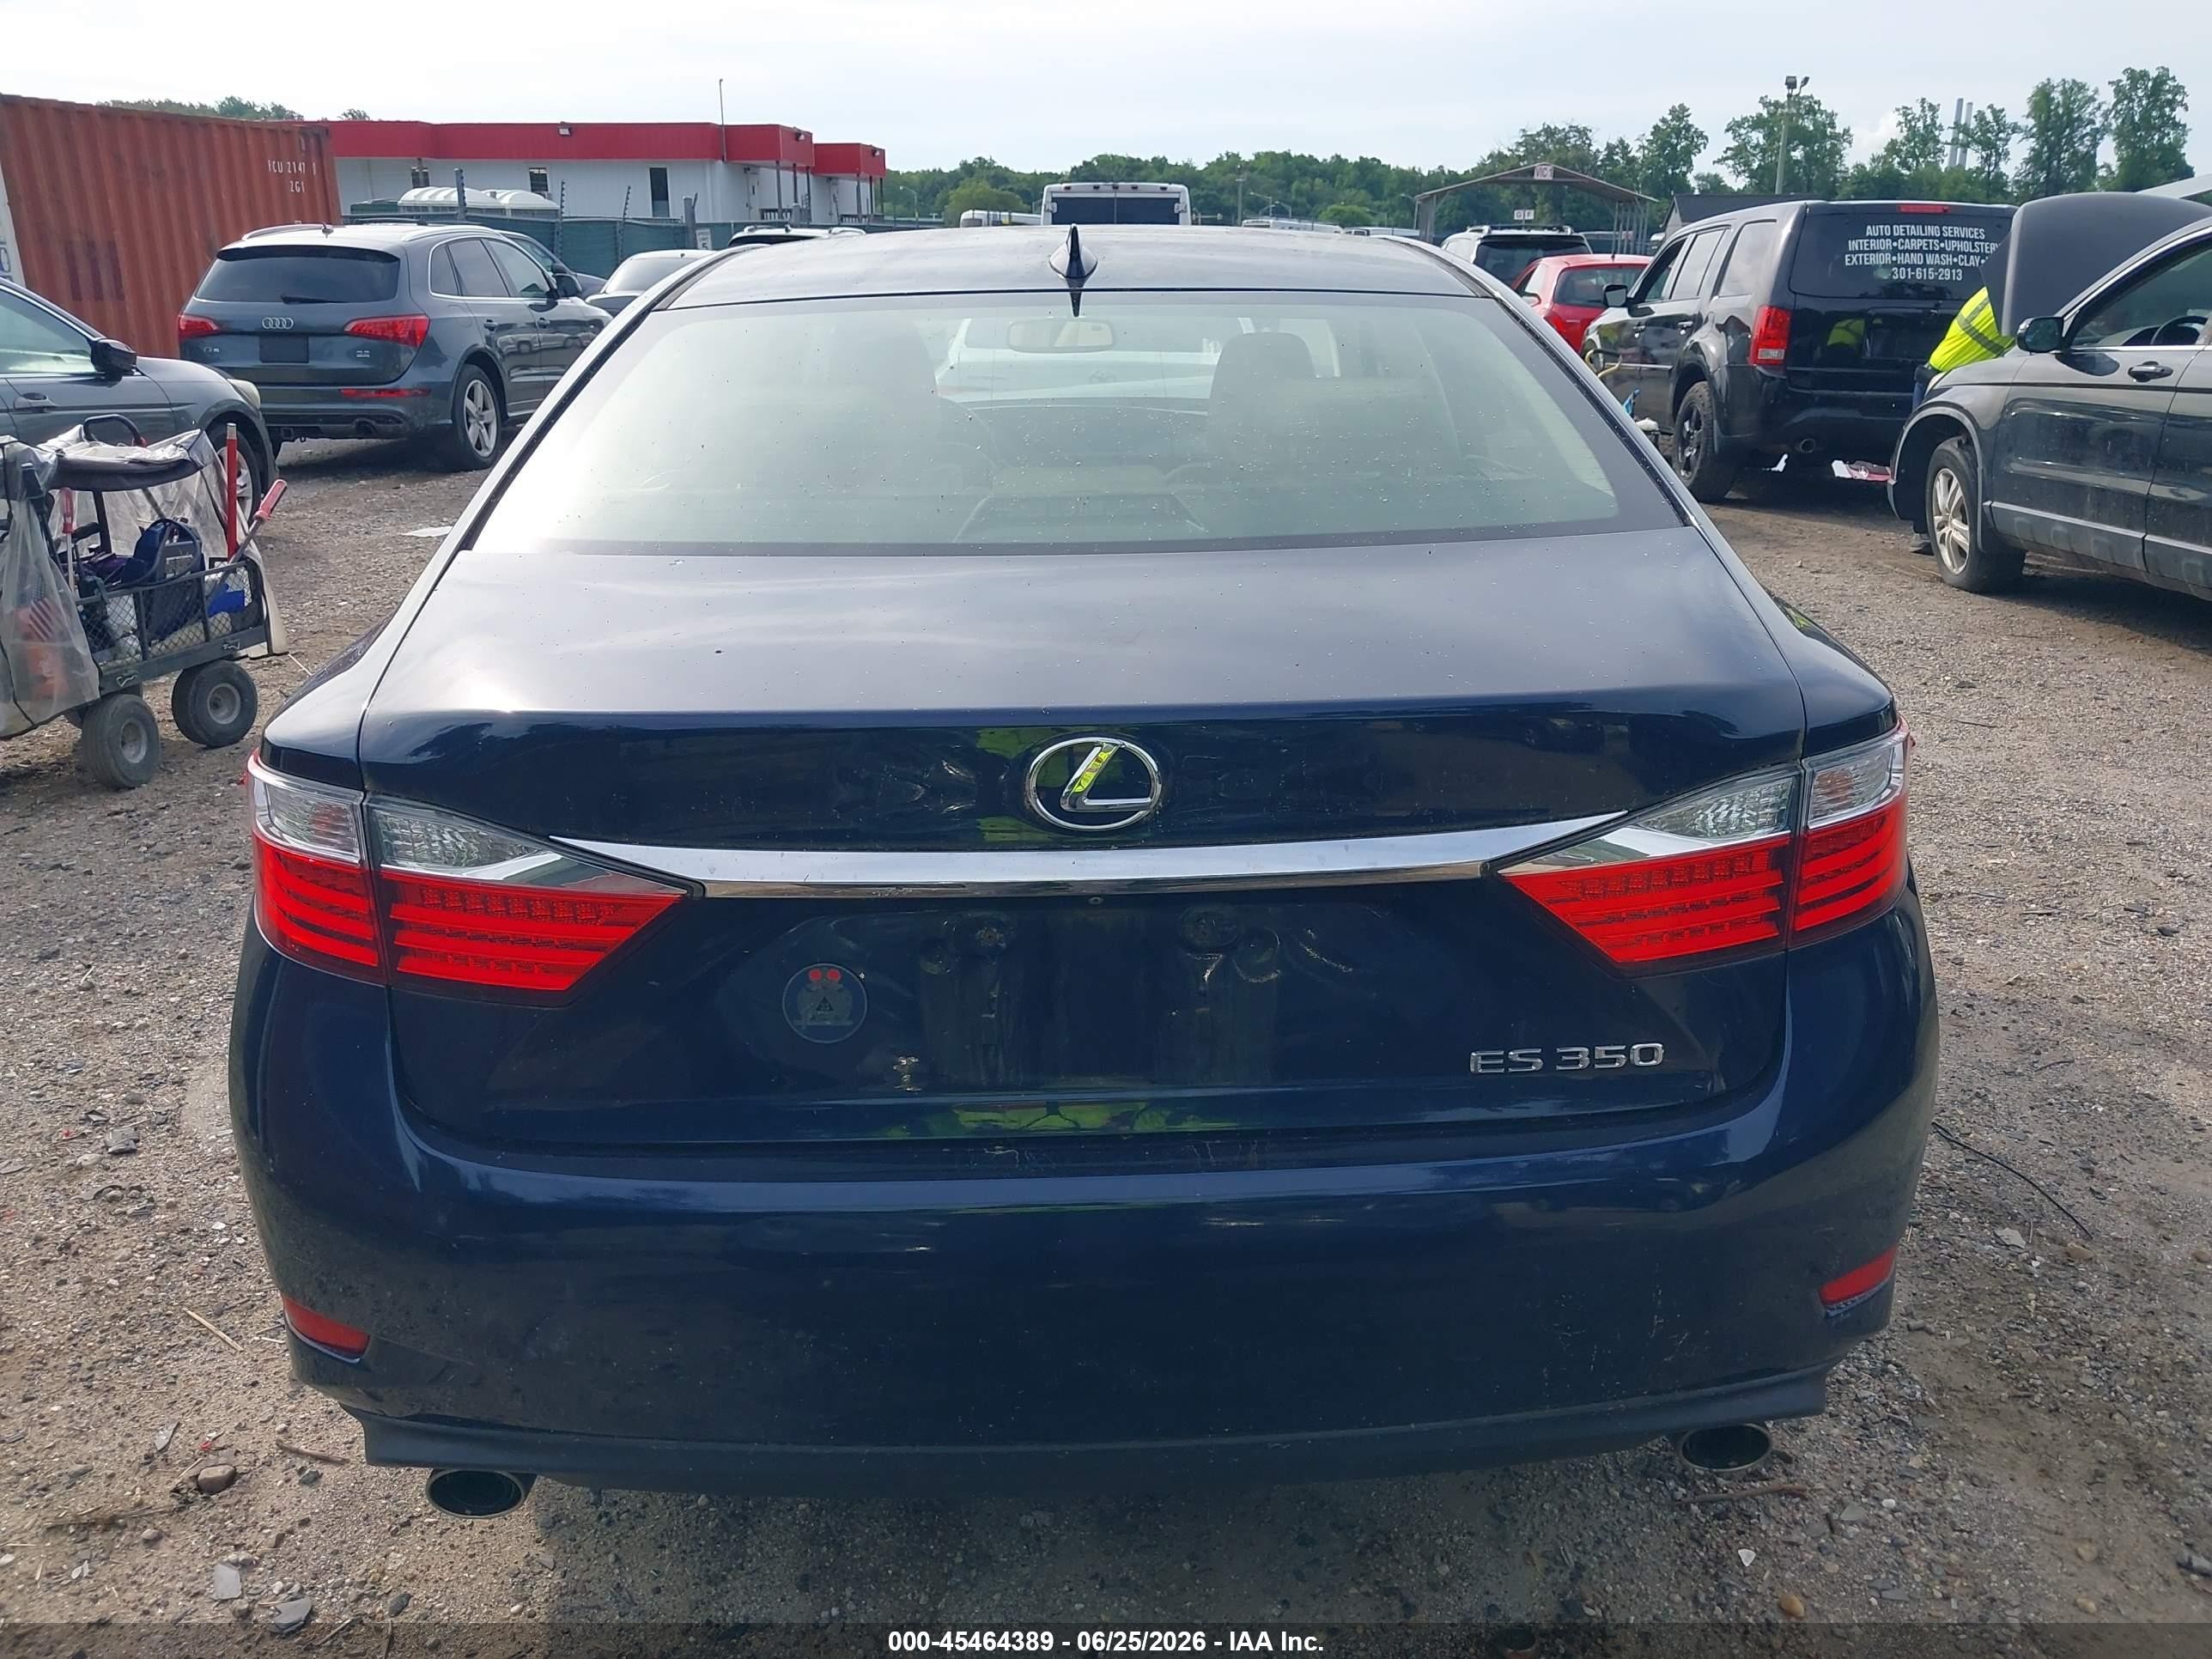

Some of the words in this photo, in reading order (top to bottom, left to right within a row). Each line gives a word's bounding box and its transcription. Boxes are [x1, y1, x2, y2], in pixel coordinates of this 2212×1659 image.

[1866, 225, 1891, 237] AUTO
[1893, 225, 1941, 238] DETAILING
[1942, 226, 1985, 240] SERVICES
[1897, 252, 1923, 265] HAND
[1925, 253, 1953, 266] WASH
[1892, 267, 1963, 281] 301-615-2913
[1469, 1048, 1544, 1073] ES
[1556, 1042, 1665, 1070] 350
